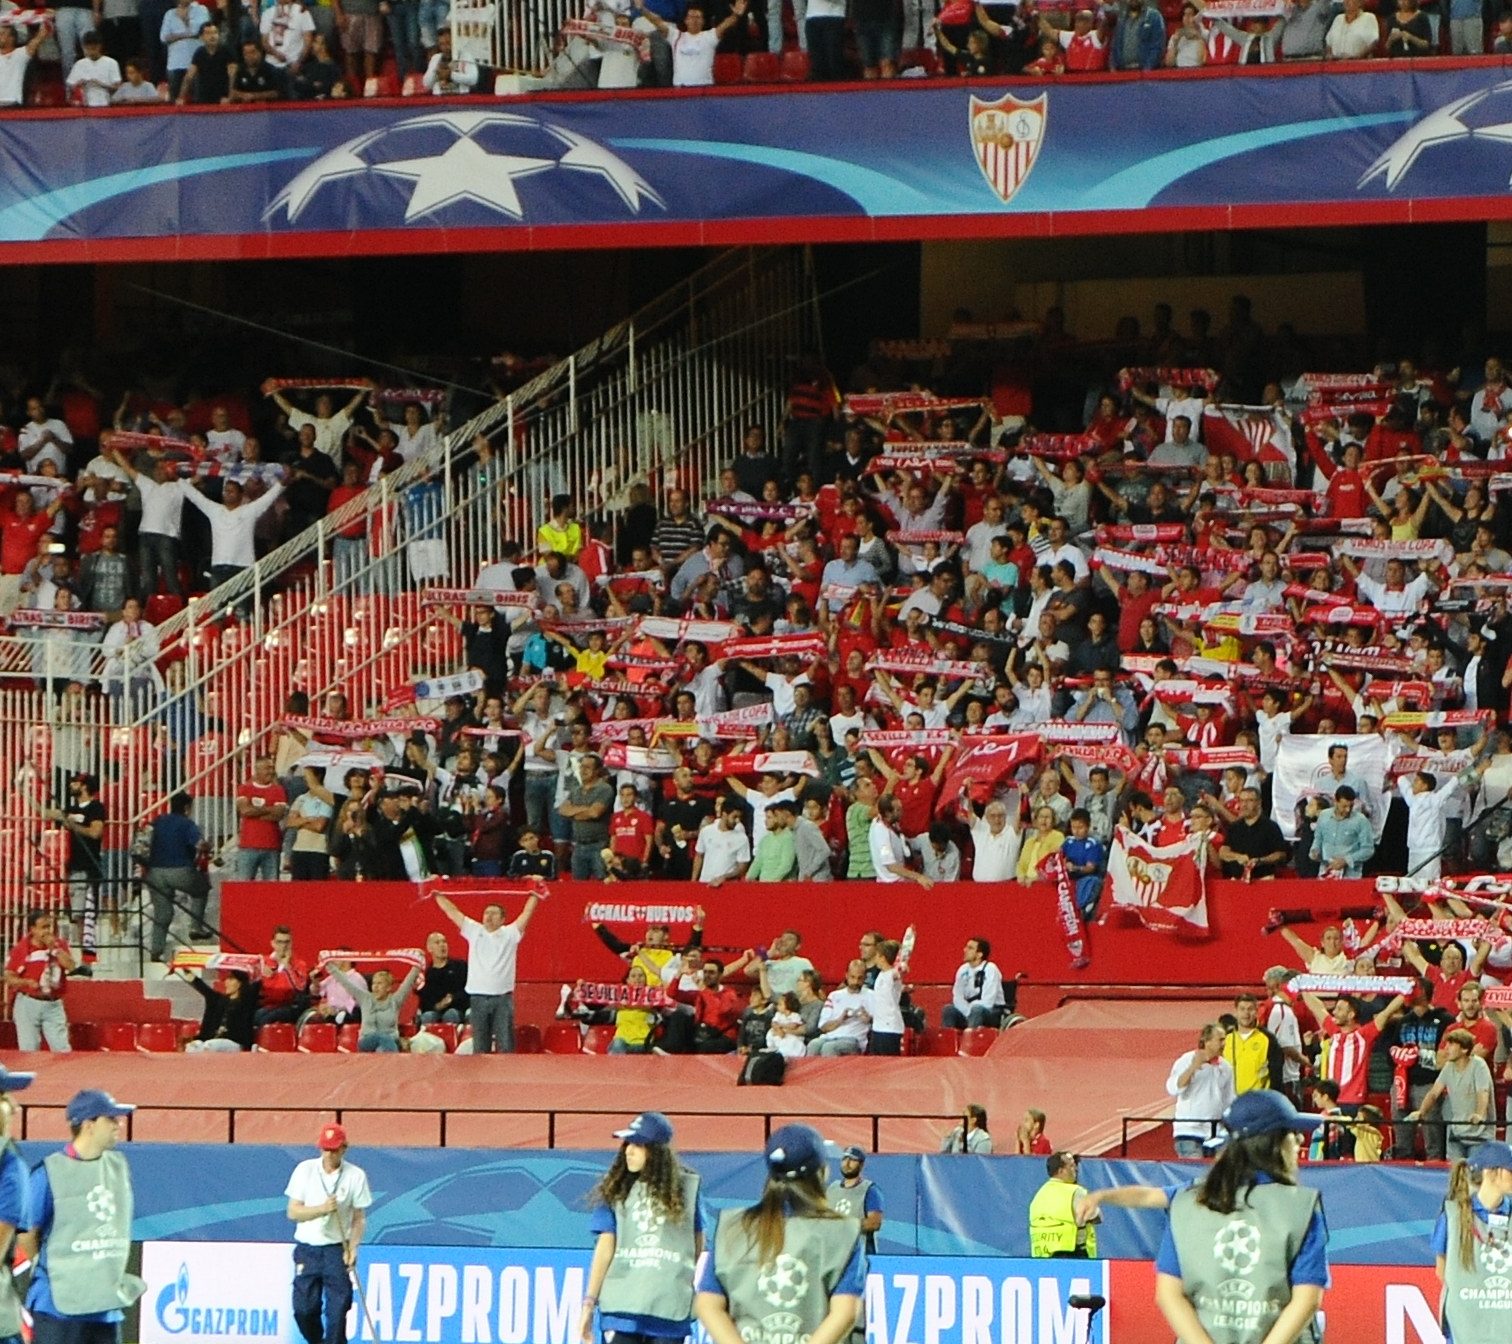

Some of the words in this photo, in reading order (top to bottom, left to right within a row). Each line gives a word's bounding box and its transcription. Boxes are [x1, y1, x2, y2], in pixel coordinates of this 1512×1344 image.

[495, 593, 529, 604] BIRIS
[590, 678, 634, 692] Sevilla
[867, 732, 912, 741] SEVILLA
[579, 984, 629, 1003] SEVILLA
[1221, 1278, 1256, 1295] UEFA
[1483, 1276, 1510, 1288] UEFA
[191, 1309, 278, 1336] GAZPROM
